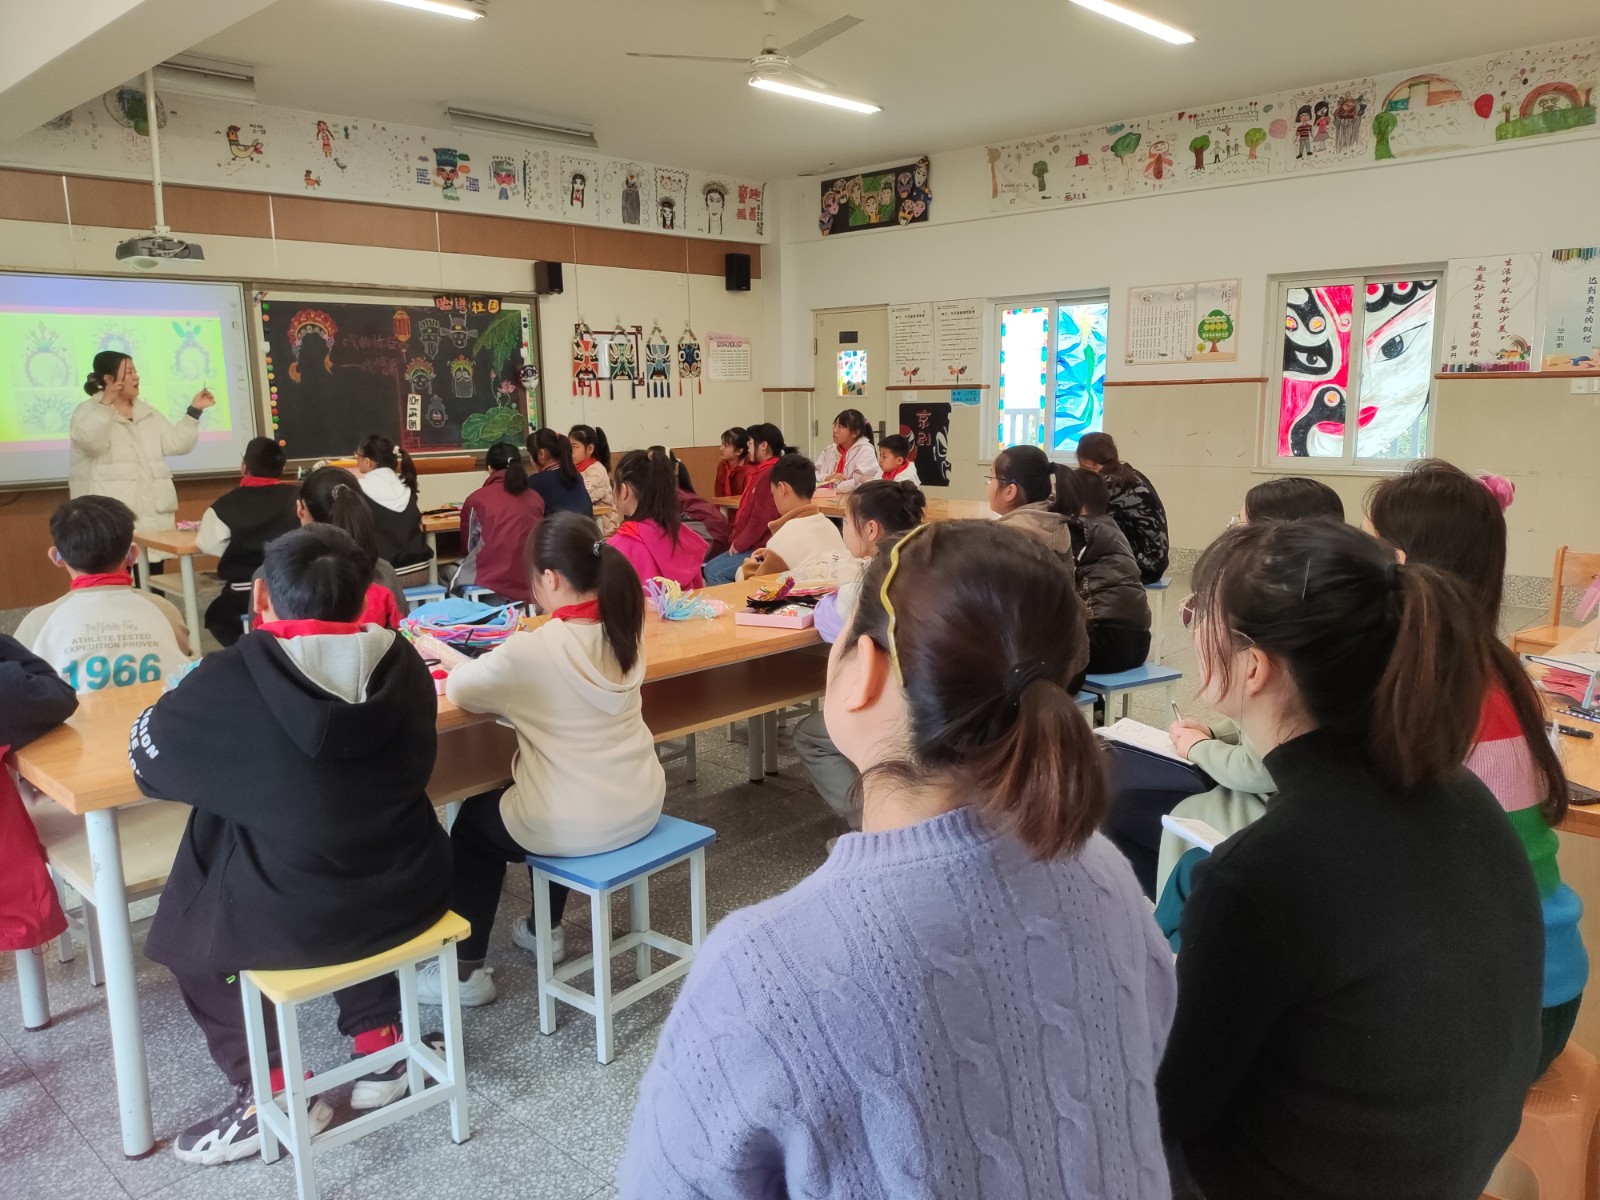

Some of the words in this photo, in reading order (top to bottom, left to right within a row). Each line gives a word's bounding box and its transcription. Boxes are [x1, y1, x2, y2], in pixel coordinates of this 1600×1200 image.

[916, 409, 931, 446] 京剧
[64, 643, 120, 654] EXPEDITION
[122, 640, 159, 648] PROVEN
[71, 635, 112, 645] ATHLETE
[116, 633, 151, 641] TESTED
[62, 653, 161, 691] 1966
